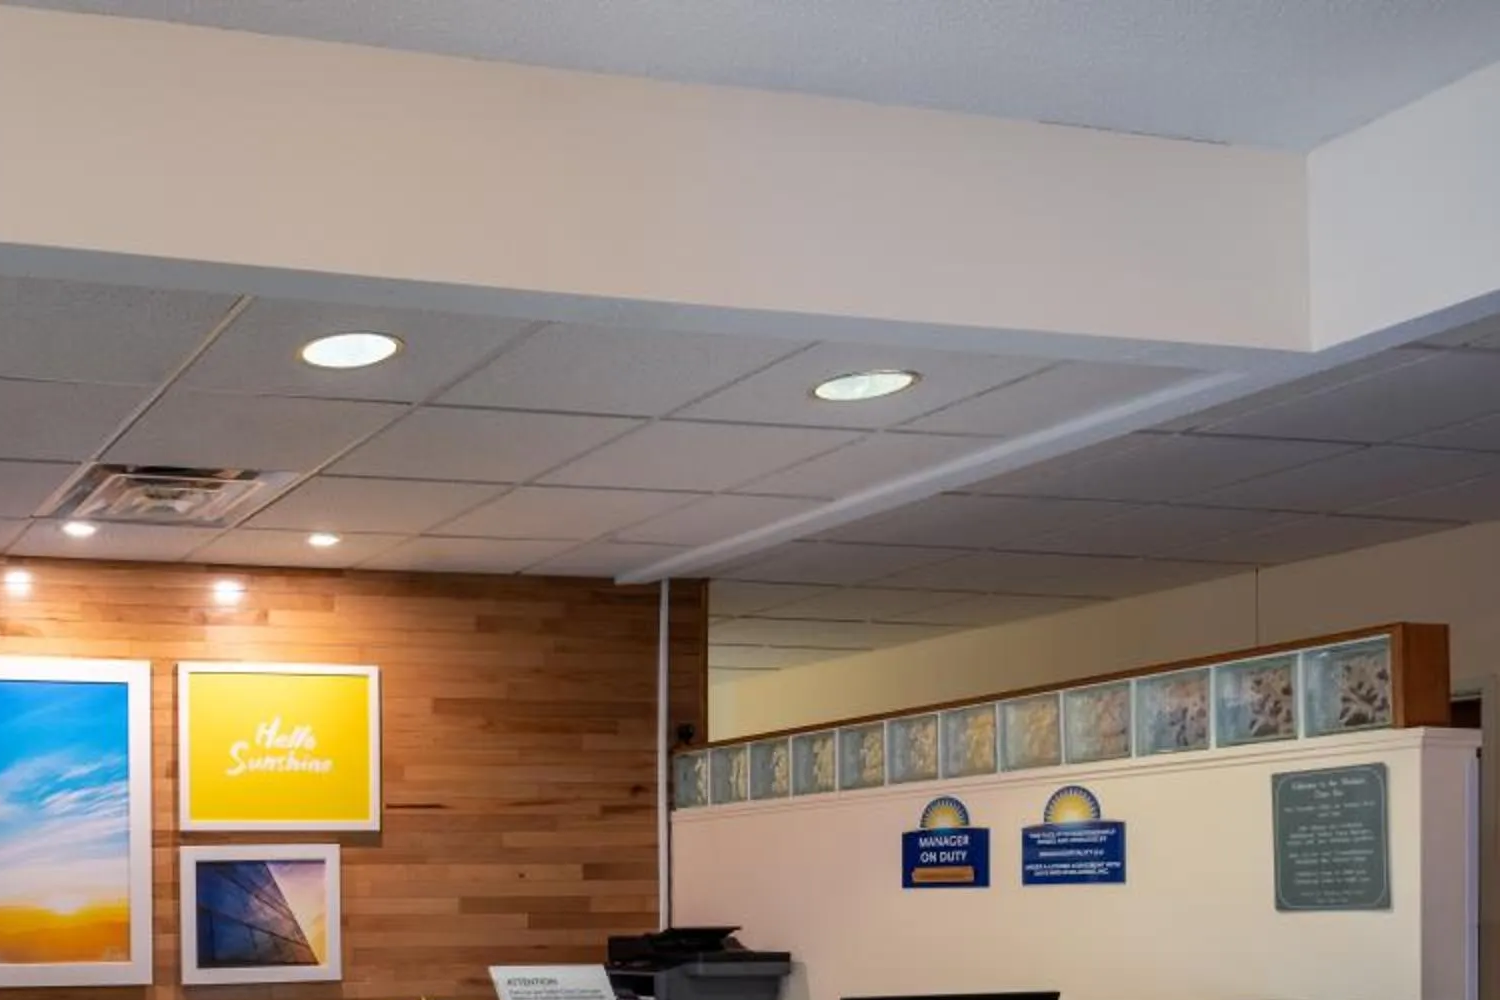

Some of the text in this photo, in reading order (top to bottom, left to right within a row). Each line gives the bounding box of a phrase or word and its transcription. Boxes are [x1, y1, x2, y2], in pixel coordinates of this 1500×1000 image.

[255, 714, 317, 750] Hello
[226, 740, 334, 776] Sunshine
[918, 834, 970, 848] MANAGER
[920, 850, 968, 863] ON DUTY
